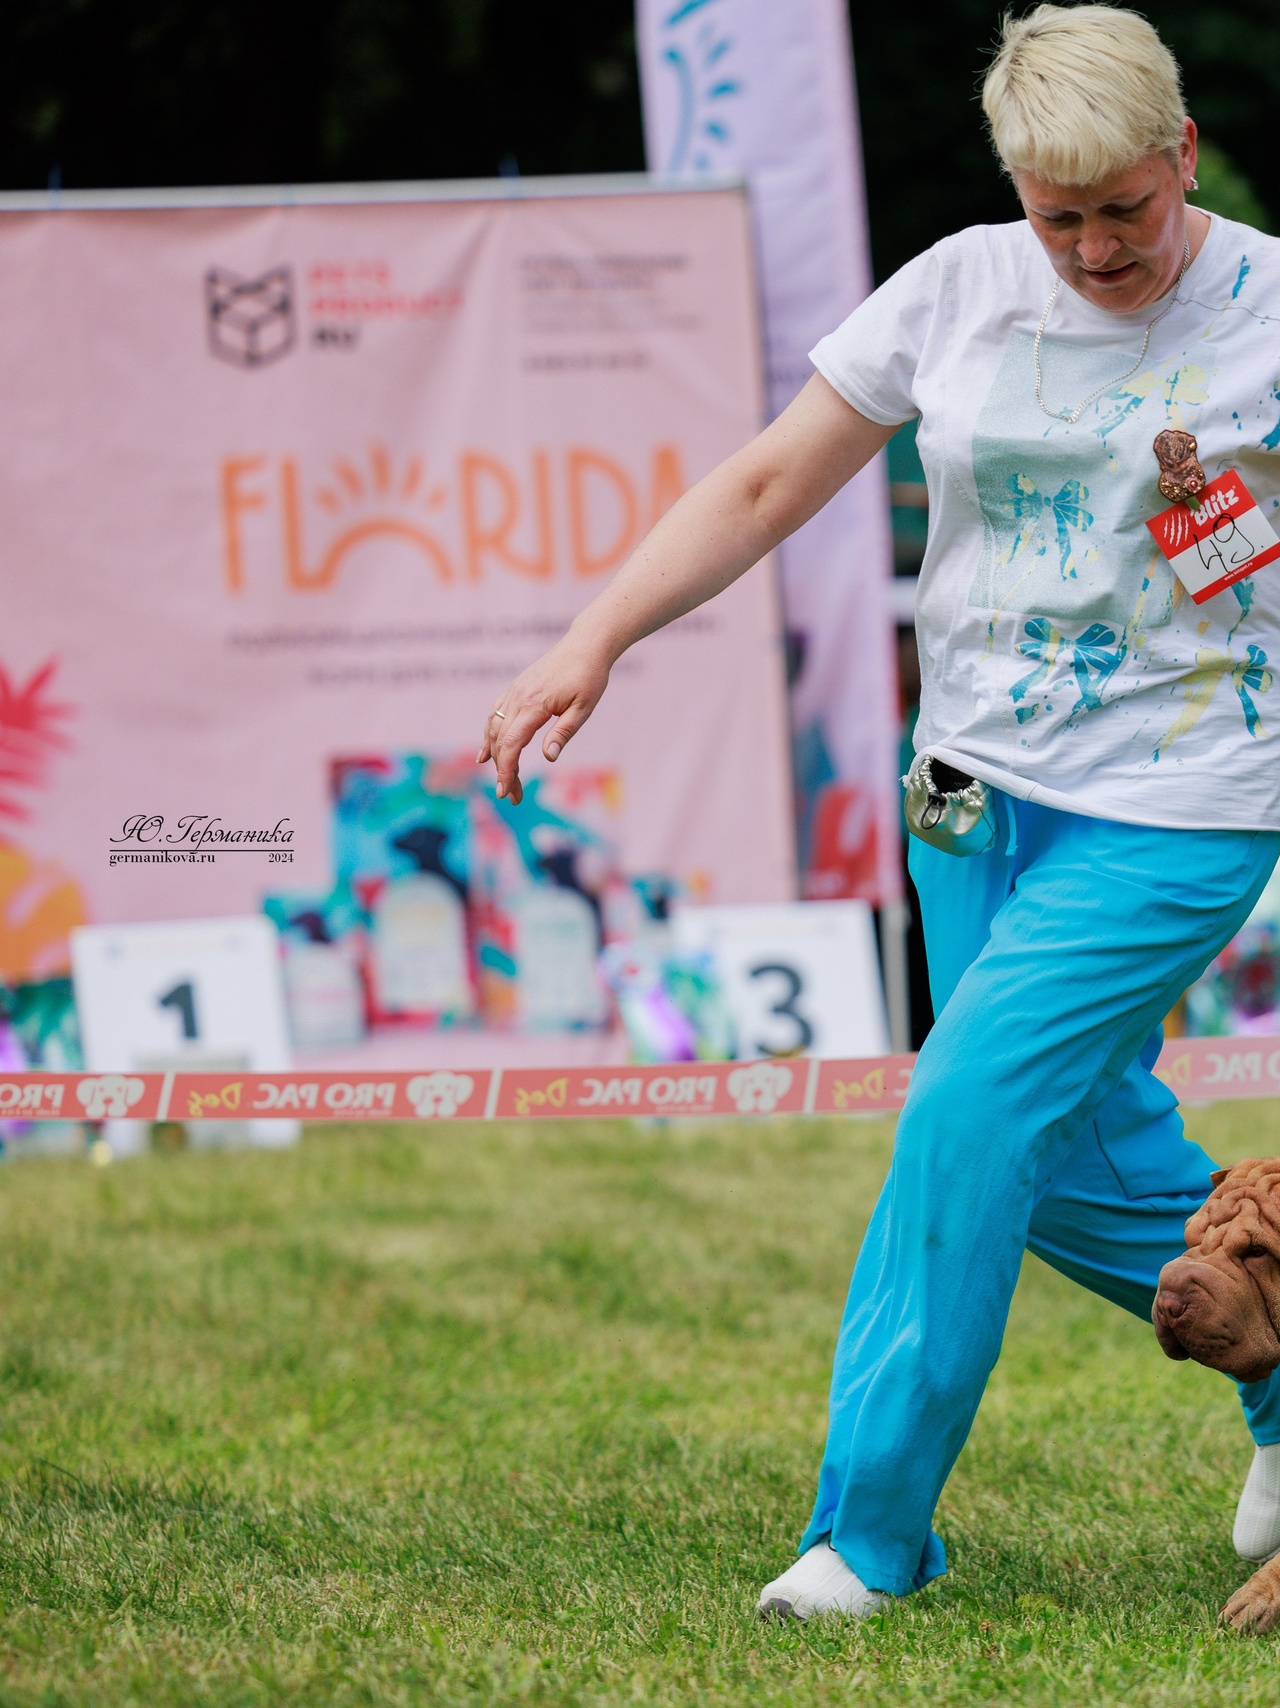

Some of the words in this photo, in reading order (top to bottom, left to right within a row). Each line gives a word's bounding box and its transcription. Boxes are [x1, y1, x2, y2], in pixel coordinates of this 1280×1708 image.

[1191, 488, 1240, 526] Blitz
[1193, 513, 1255, 574] 49
[159, 982, 198, 1039] 1
[749, 962, 814, 1057] 3
